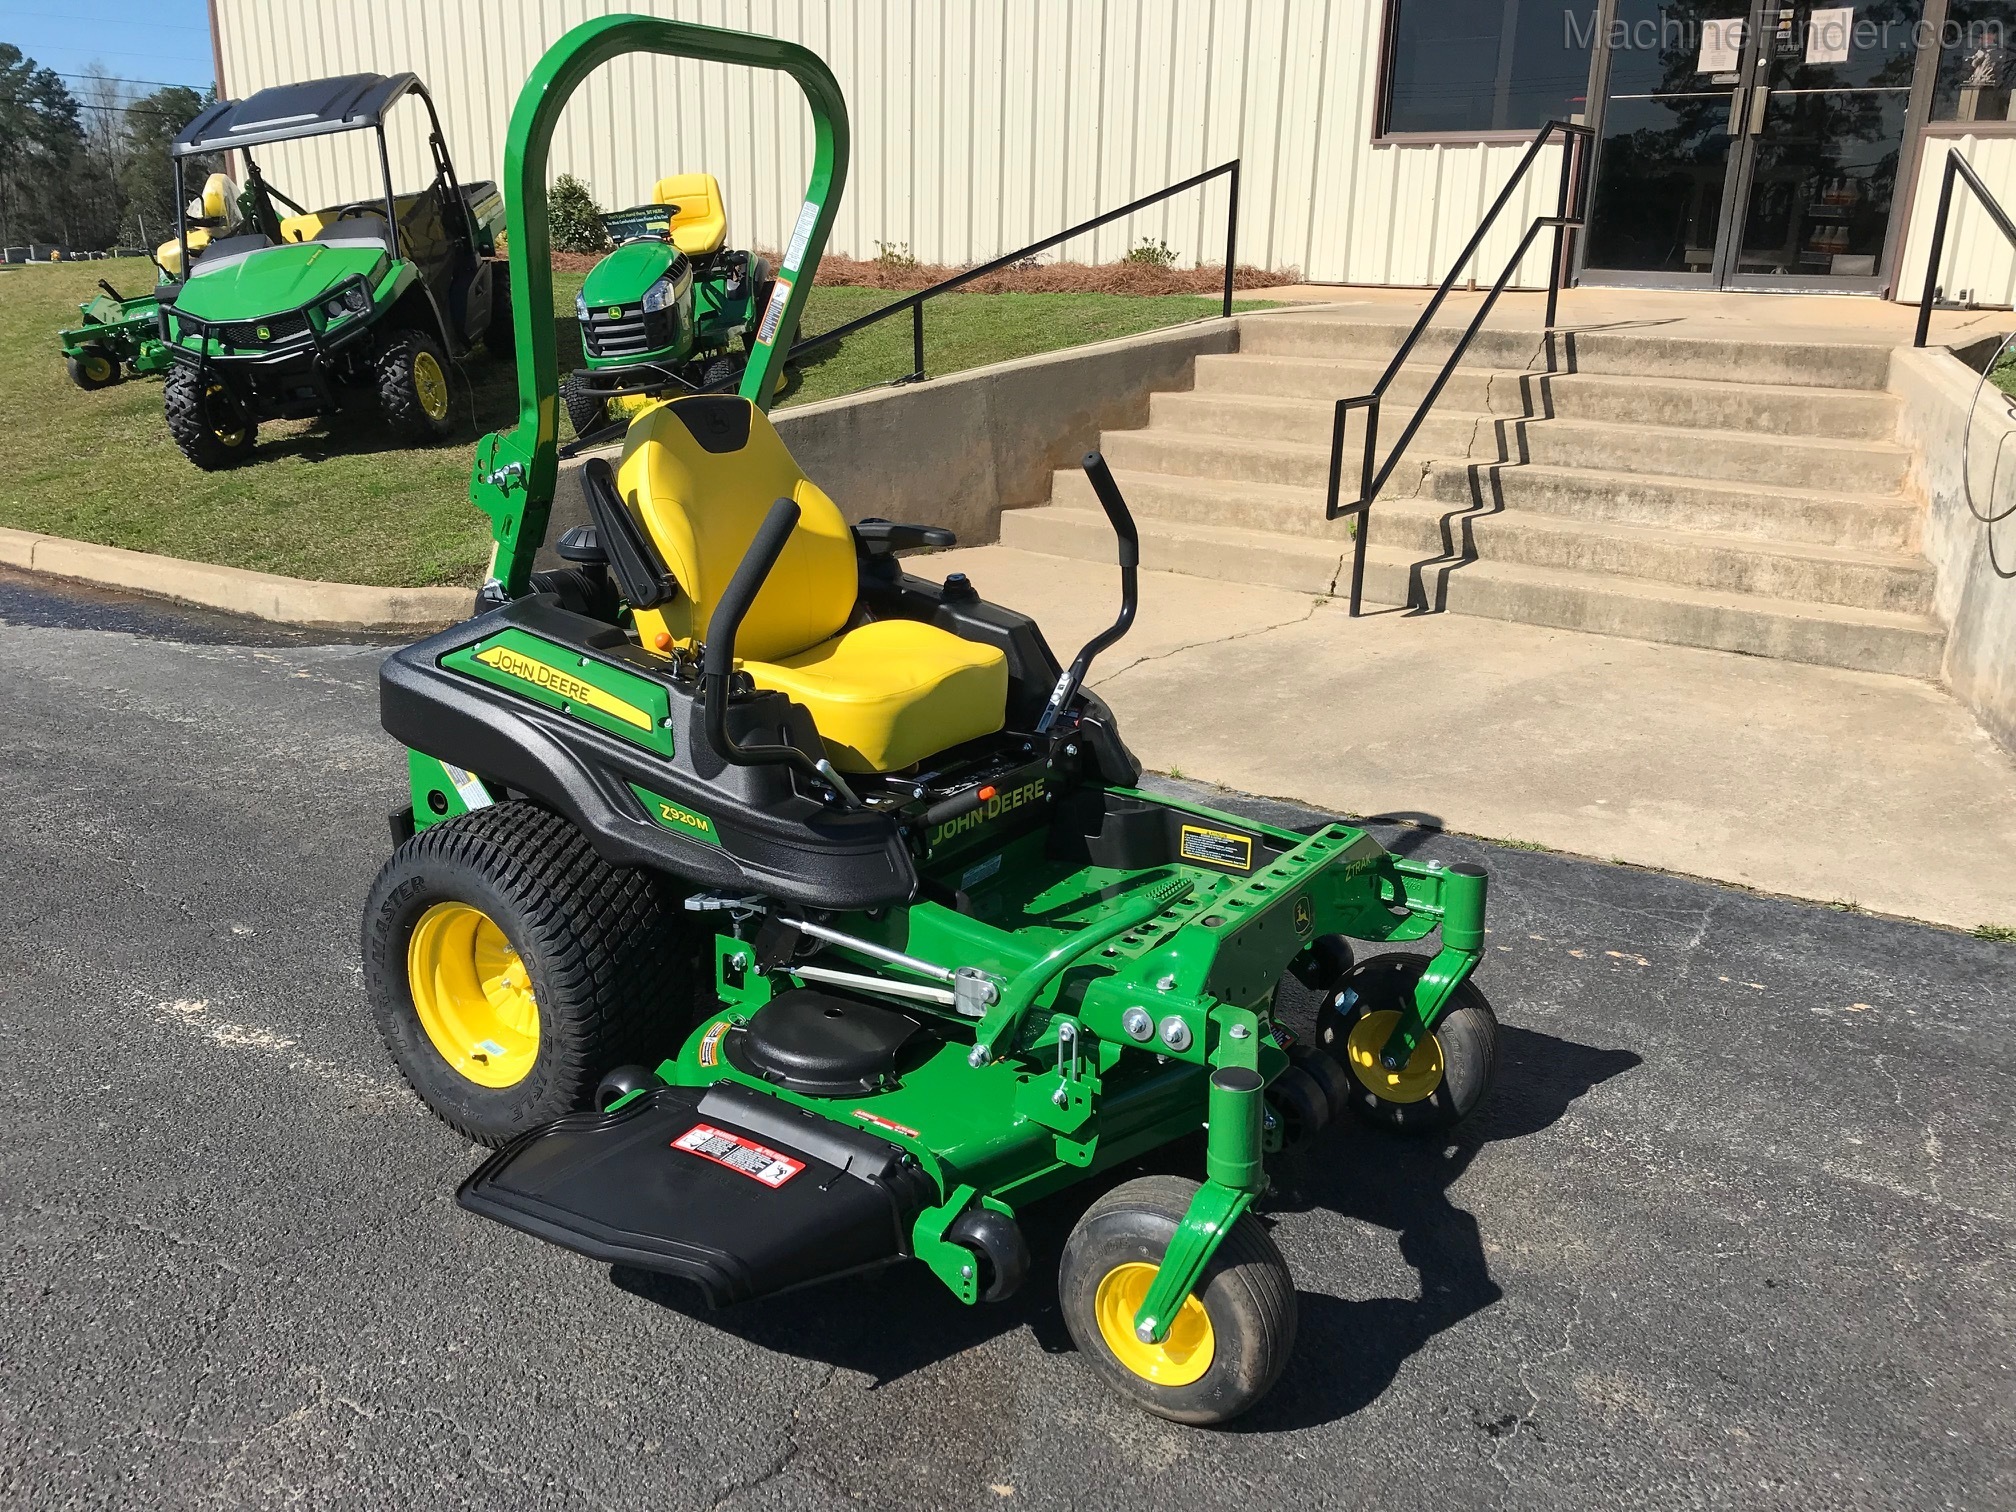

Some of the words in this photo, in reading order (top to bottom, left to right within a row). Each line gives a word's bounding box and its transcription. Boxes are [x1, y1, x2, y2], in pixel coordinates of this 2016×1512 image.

[492, 650, 535, 679] JOHN
[537, 666, 591, 702] DEERE
[659, 803, 709, 832] Z920M
[932, 806, 983, 846] JOHN
[988, 777, 1045, 820] DEERE
